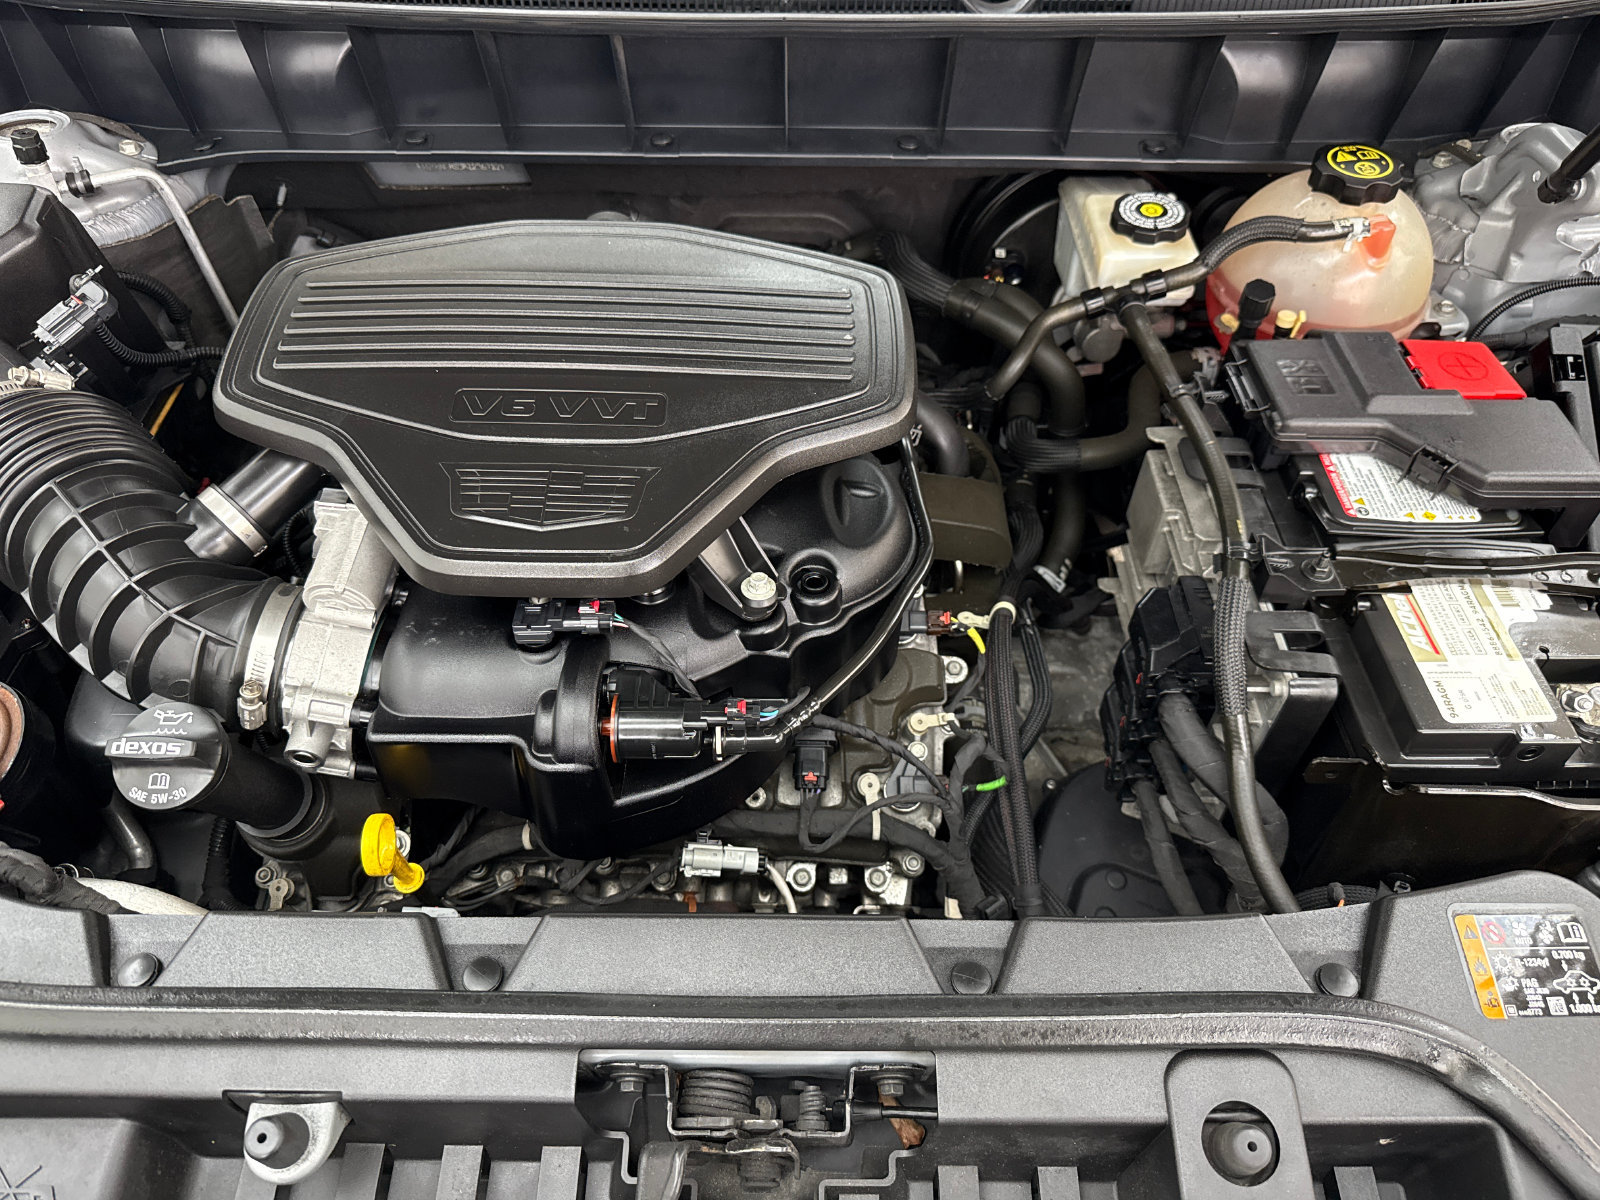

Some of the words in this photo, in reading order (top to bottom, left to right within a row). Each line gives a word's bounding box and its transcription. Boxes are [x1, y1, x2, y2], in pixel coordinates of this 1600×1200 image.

[463, 395, 536, 416] V6
[549, 396, 658, 420] VVT
[1386, 593, 1432, 651] ACDel
[1432, 680, 1460, 718] 94RAGM
[111, 738, 182, 755] dexos
[129, 786, 148, 803] SAE
[150, 787, 187, 804] 5W-30
[1515, 937, 1533, 945] AUTO
[1515, 957, 1550, 968] R-1234yf
[1552, 950, 1574, 959] 0.700
[1573, 950, 1586, 961] kg
[1521, 978, 1539, 988] PAG
